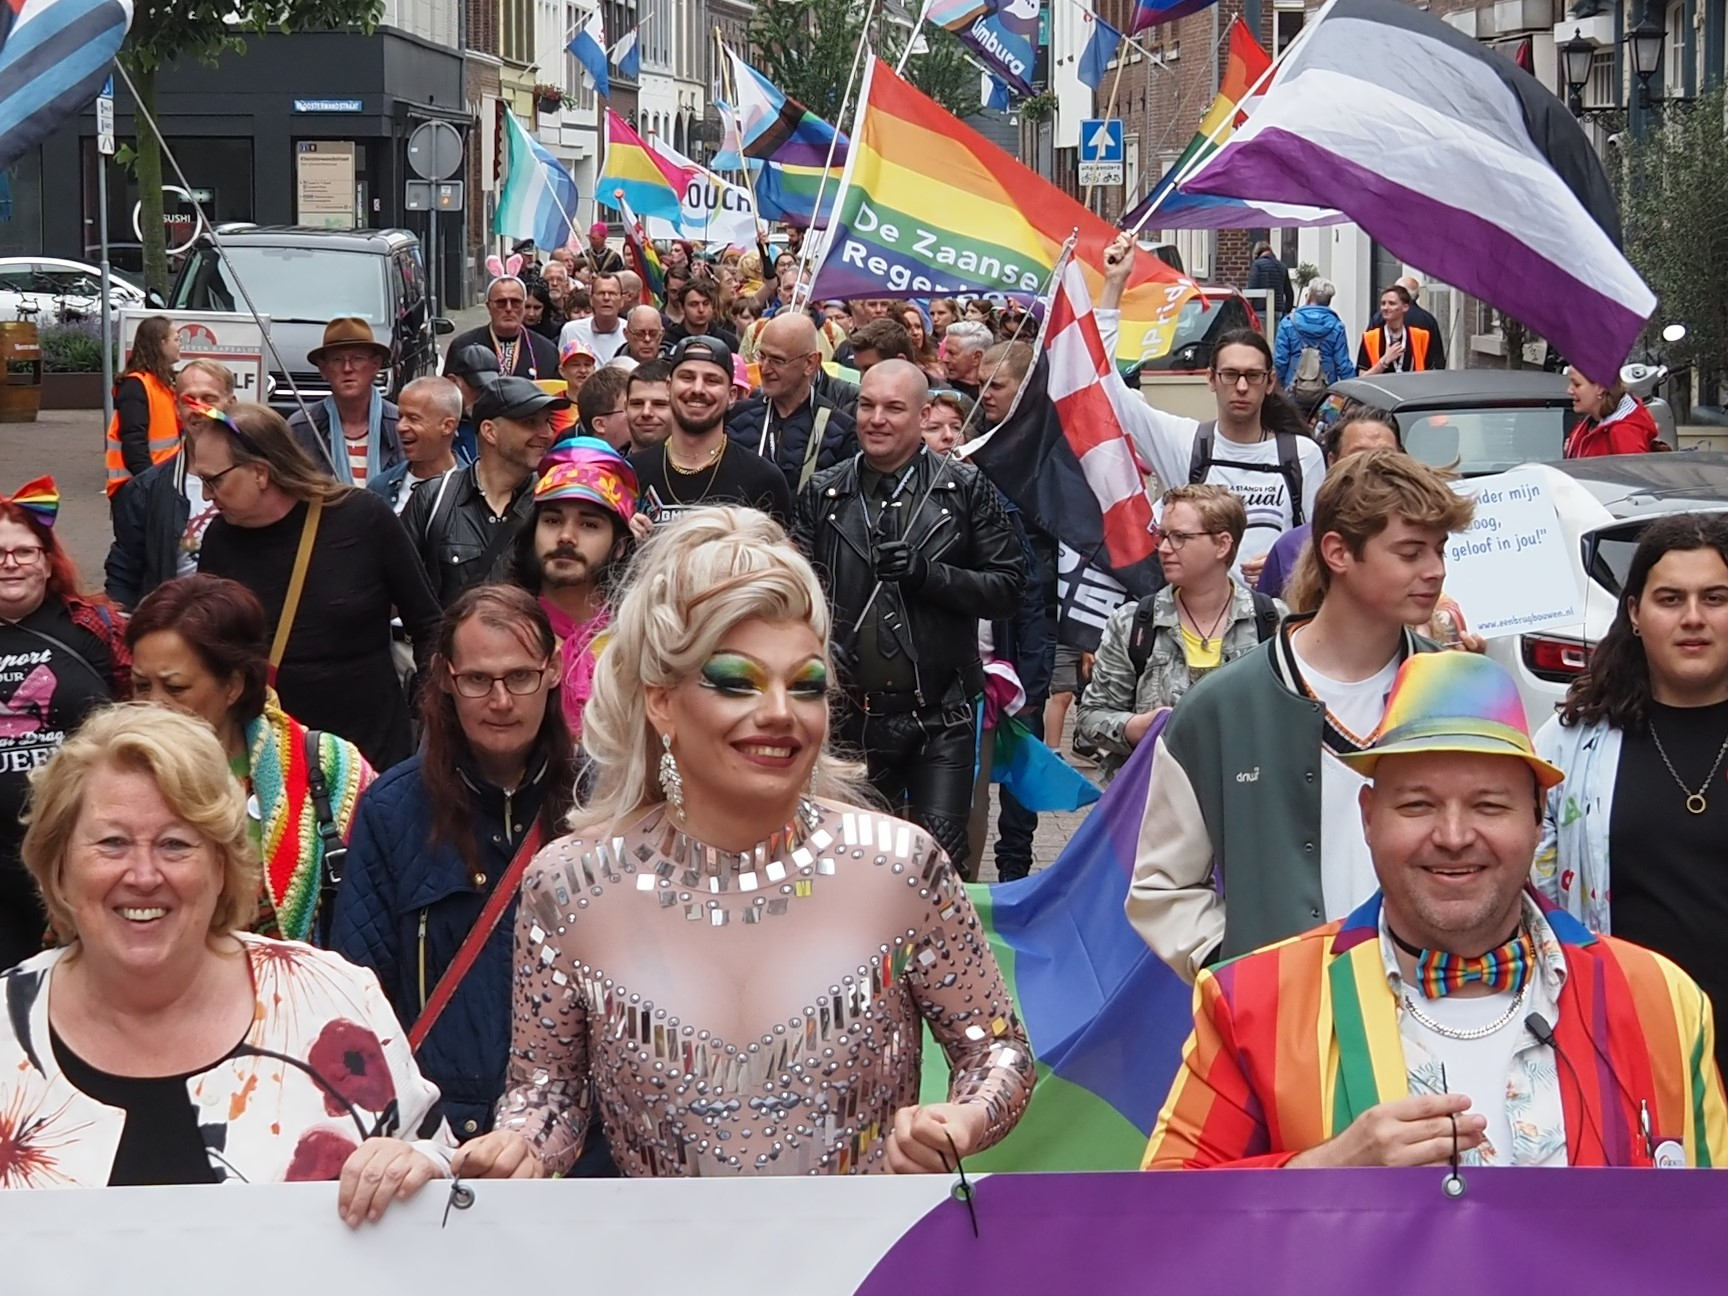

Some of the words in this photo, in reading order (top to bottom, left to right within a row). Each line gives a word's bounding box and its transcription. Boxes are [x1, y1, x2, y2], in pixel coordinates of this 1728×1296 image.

[854, 201, 900, 243] De
[912, 228, 1039, 292] Zaanse
[1509, 484, 1540, 502] mijn
[1452, 537, 1492, 561] geloof
[1498, 536, 1511, 550] in
[1478, 606, 1574, 630] www.eenbrugbouwen.nl
[18, 730, 65, 746] Drag
